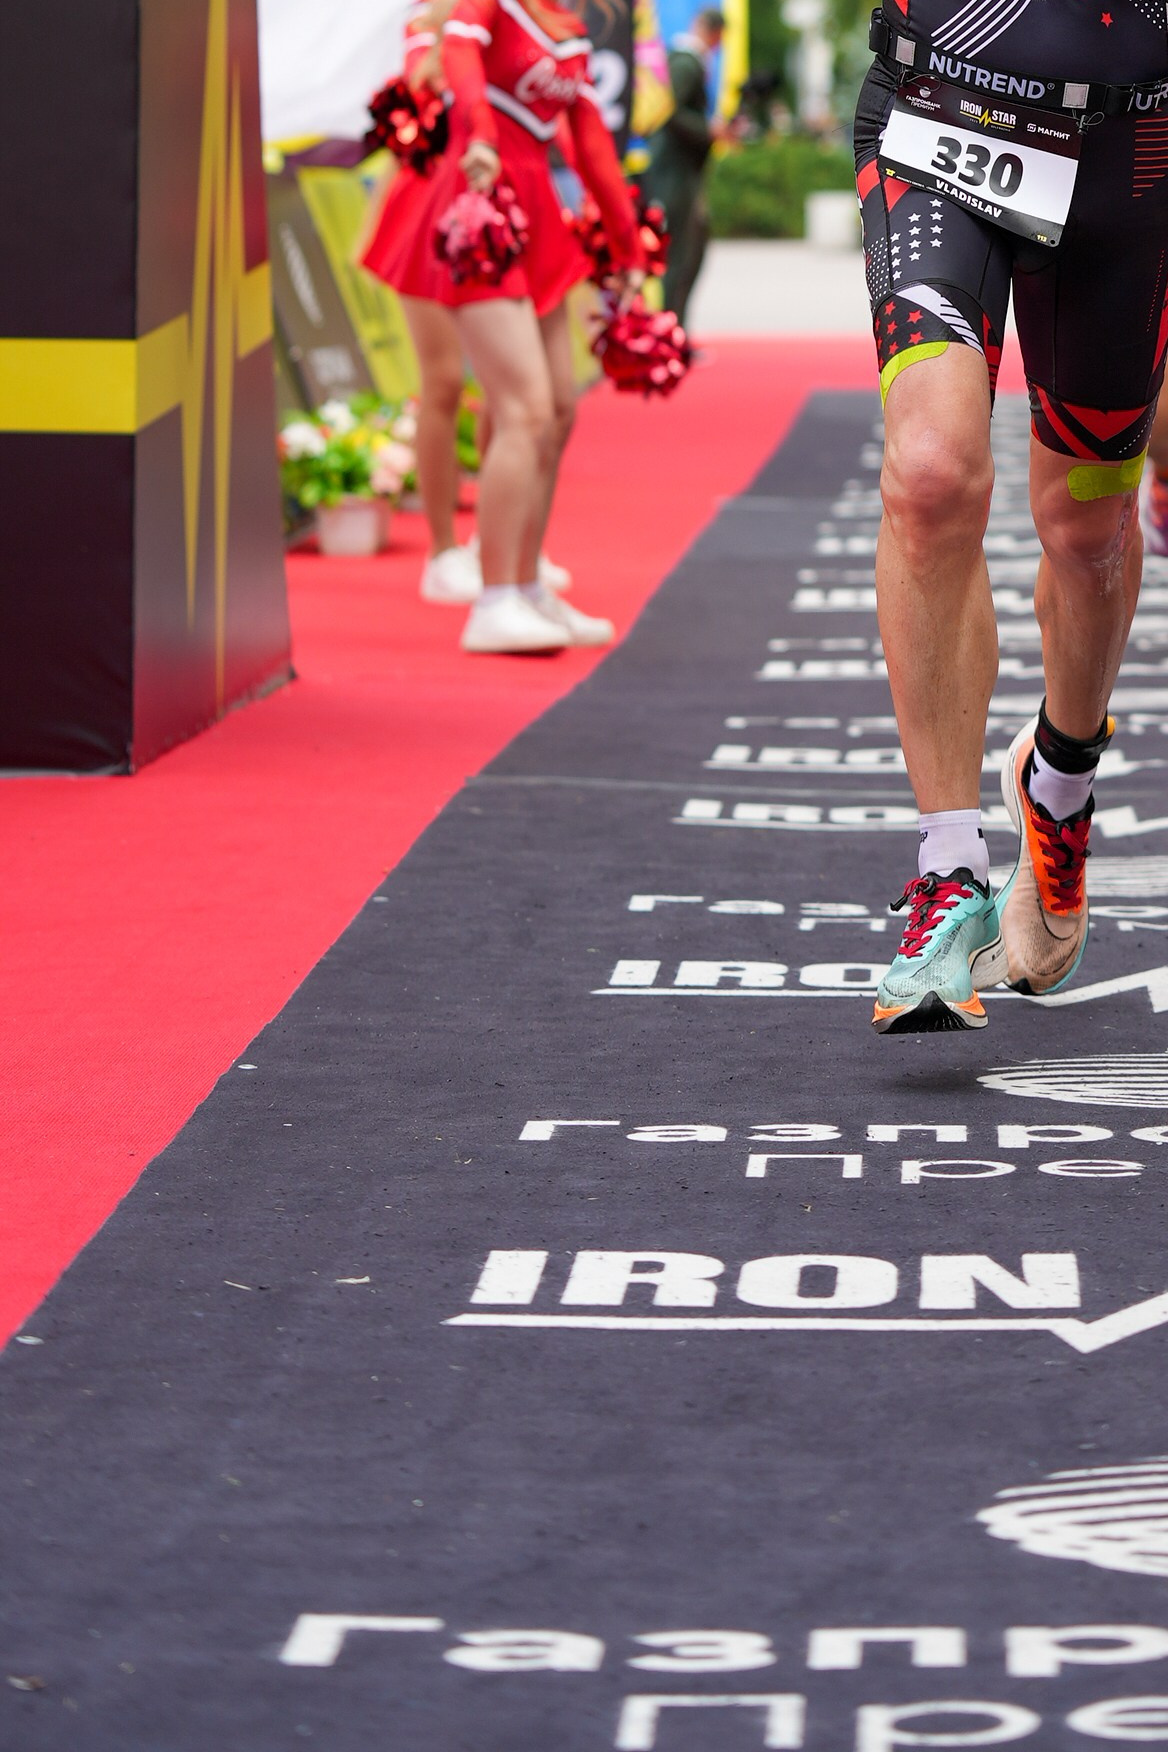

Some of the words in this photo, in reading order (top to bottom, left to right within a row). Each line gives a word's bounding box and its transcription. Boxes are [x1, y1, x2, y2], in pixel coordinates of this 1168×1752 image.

[959, 99, 983, 117] IRON
[991, 109, 1017, 126] STAR
[1036, 126, 1071, 141] МАГНИТ
[930, 135, 1025, 198] 330
[935, 178, 1004, 219] VLADISLAV
[608, 959, 894, 988] IRO
[470, 1249, 1081, 1310] IRON
